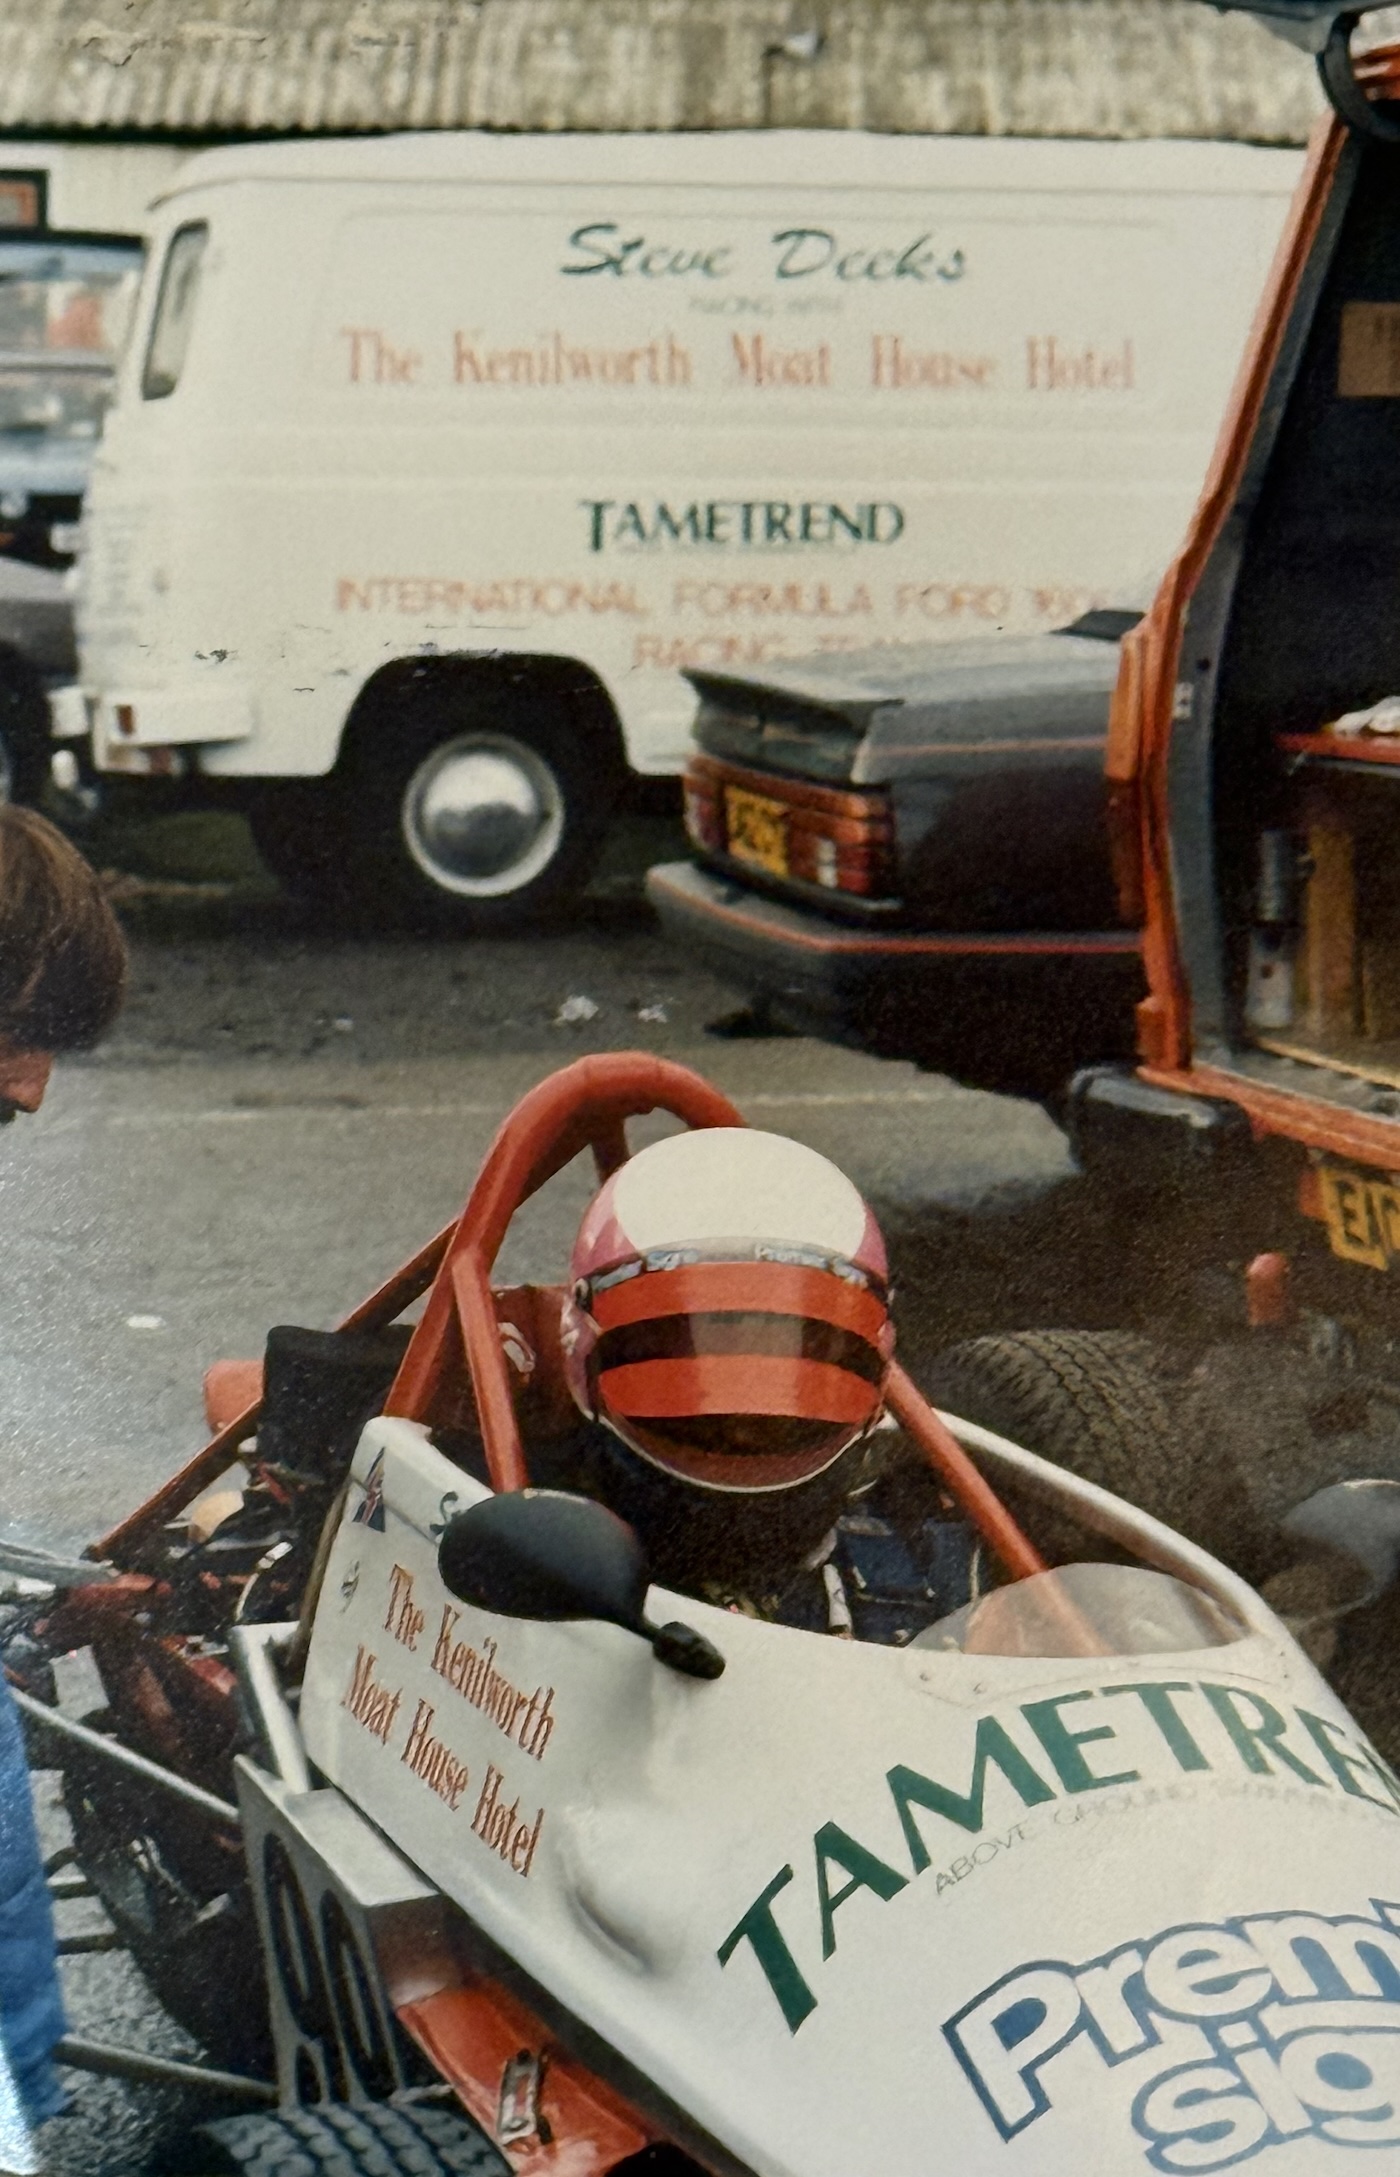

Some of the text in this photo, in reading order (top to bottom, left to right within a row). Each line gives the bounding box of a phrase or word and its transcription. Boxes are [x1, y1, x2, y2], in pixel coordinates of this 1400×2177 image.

[560, 222, 967, 283] Steve Deeks
[340, 325, 1135, 390] The Kenilworth Moat House Hotel
[577, 498, 906, 551] TAMETREND
[335, 577, 648, 617] INTERNATIONAL
[672, 579, 873, 617] FORMULA
[895, 582, 1010, 620] FORD
[383, 1563, 555, 1762] The Kenilworth
[340, 1643, 545, 1877] Moat House Hotel
